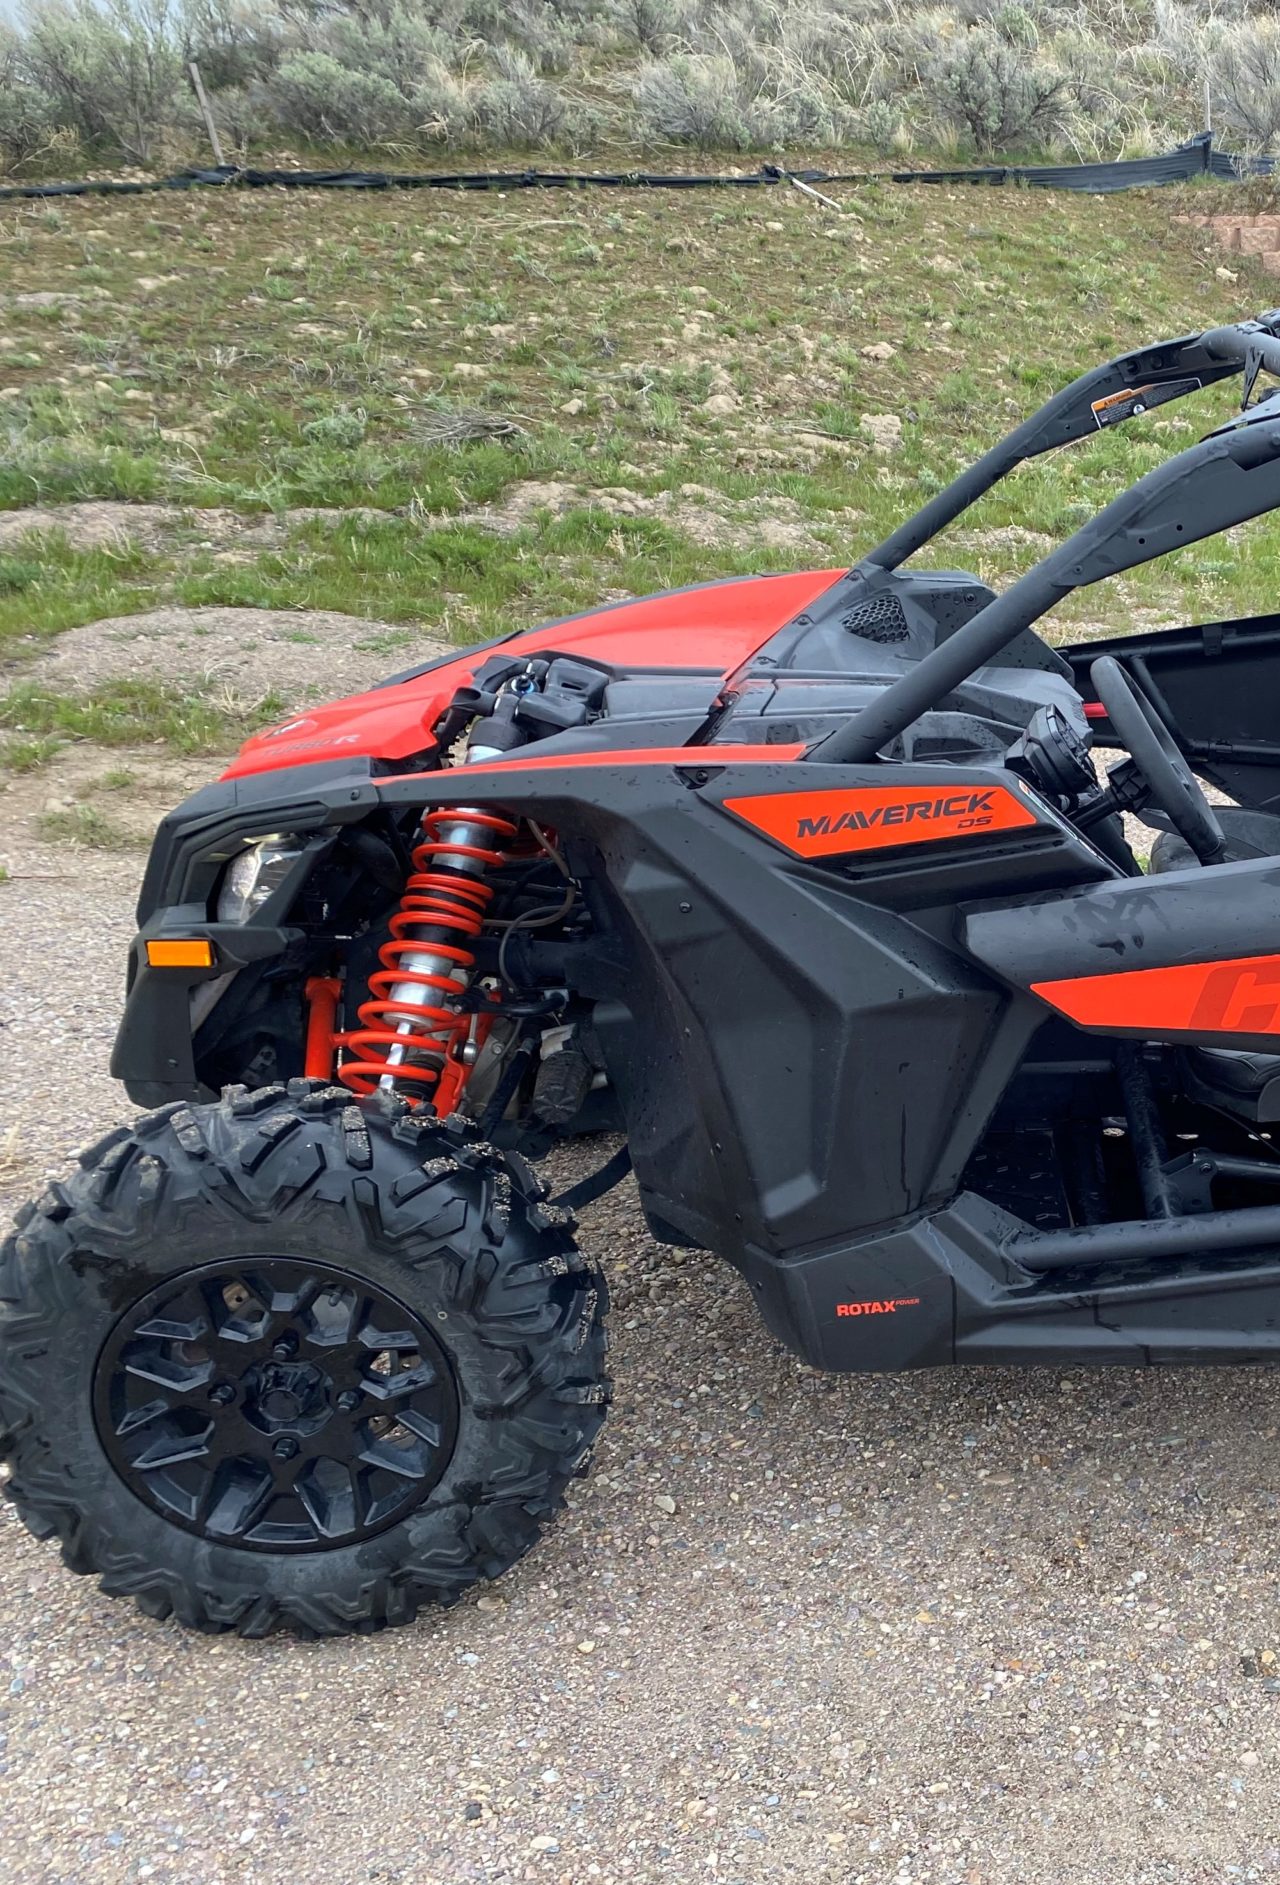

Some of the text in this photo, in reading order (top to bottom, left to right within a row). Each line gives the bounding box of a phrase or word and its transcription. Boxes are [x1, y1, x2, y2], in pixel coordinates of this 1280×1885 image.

[797, 790, 996, 838] MAVERICK
[957, 815, 993, 830] DS
[836, 1300, 896, 1317] ROTAX
